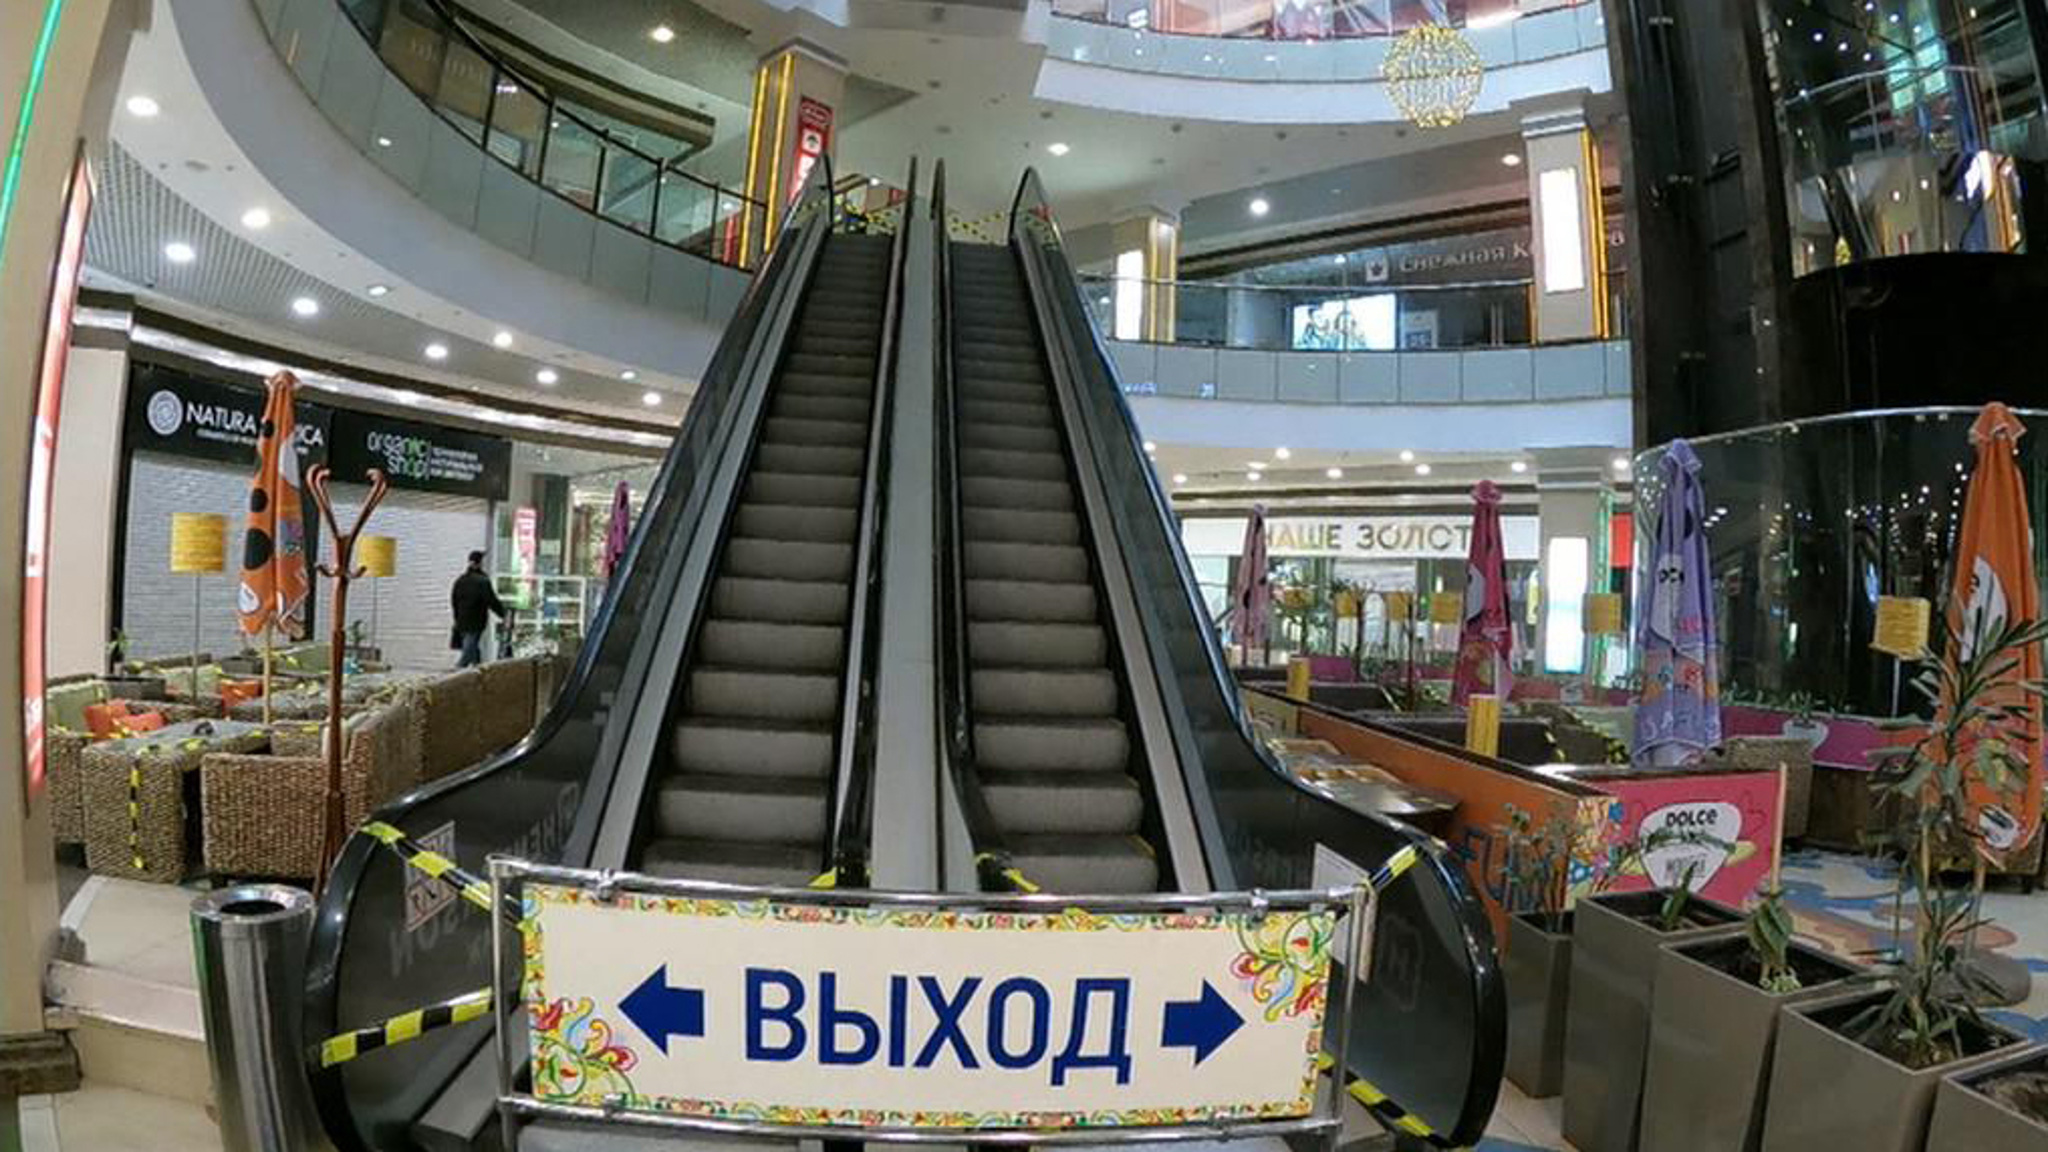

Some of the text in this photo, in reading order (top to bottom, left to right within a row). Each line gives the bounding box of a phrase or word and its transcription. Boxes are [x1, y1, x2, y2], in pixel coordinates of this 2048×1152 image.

[186, 401, 257, 434] NATURA
[387, 455, 428, 479] shop
[745, 967, 1131, 1086] ВЫХОД
